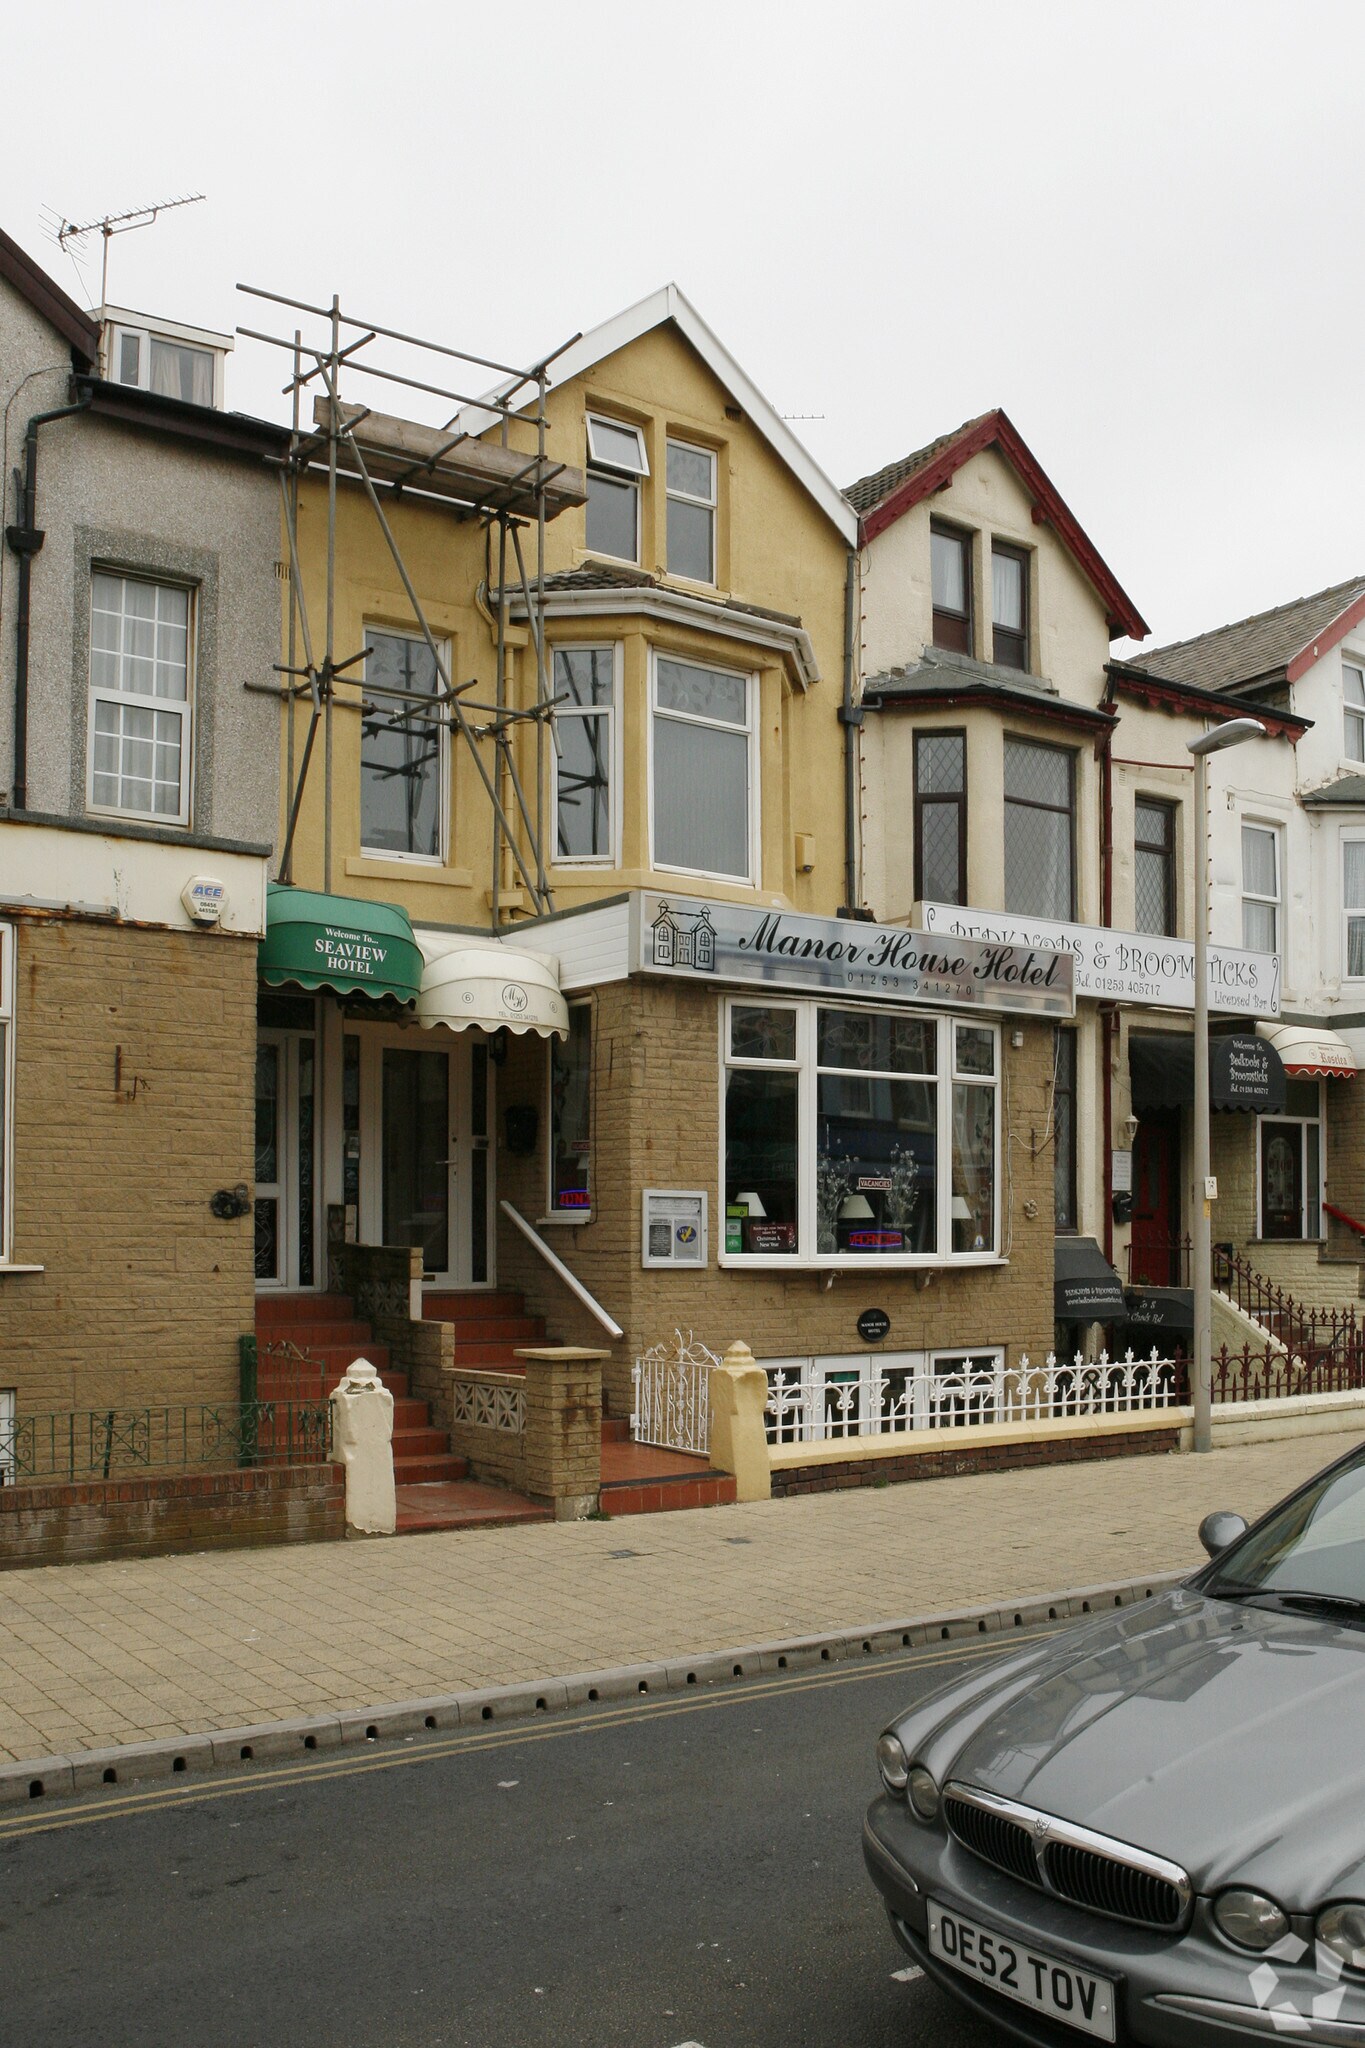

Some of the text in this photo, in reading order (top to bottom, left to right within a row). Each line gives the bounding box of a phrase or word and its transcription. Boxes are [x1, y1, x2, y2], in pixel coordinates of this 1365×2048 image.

[192, 884, 224, 898] ACE
[325, 927, 360, 941] Welcome
[314, 938, 387, 963] SEAVIEW
[738, 912, 1060, 987] Manor House Hotel
[327, 956, 374, 975] HOTEL
[1093, 941, 1110, 970] &
[1115, 943, 1258, 988] BROOMTICKS
[848, 972, 972, 995] 01253 341270
[1095, 977, 1124, 992] 01253
[1127, 980, 1161, 997] 405717
[1214, 990, 1267, 1009] Licensed Bar
[1232, 1039, 1256, 1051] Welcome
[1228, 1052, 1269, 1070] Bedknobs &
[1228, 1066, 1269, 1084] Broomsticks
[860, 1180, 891, 1188] VACANCIES
[940, 1915, 1018, 1990] OE52
[1027, 1955, 1097, 2021] TOV
